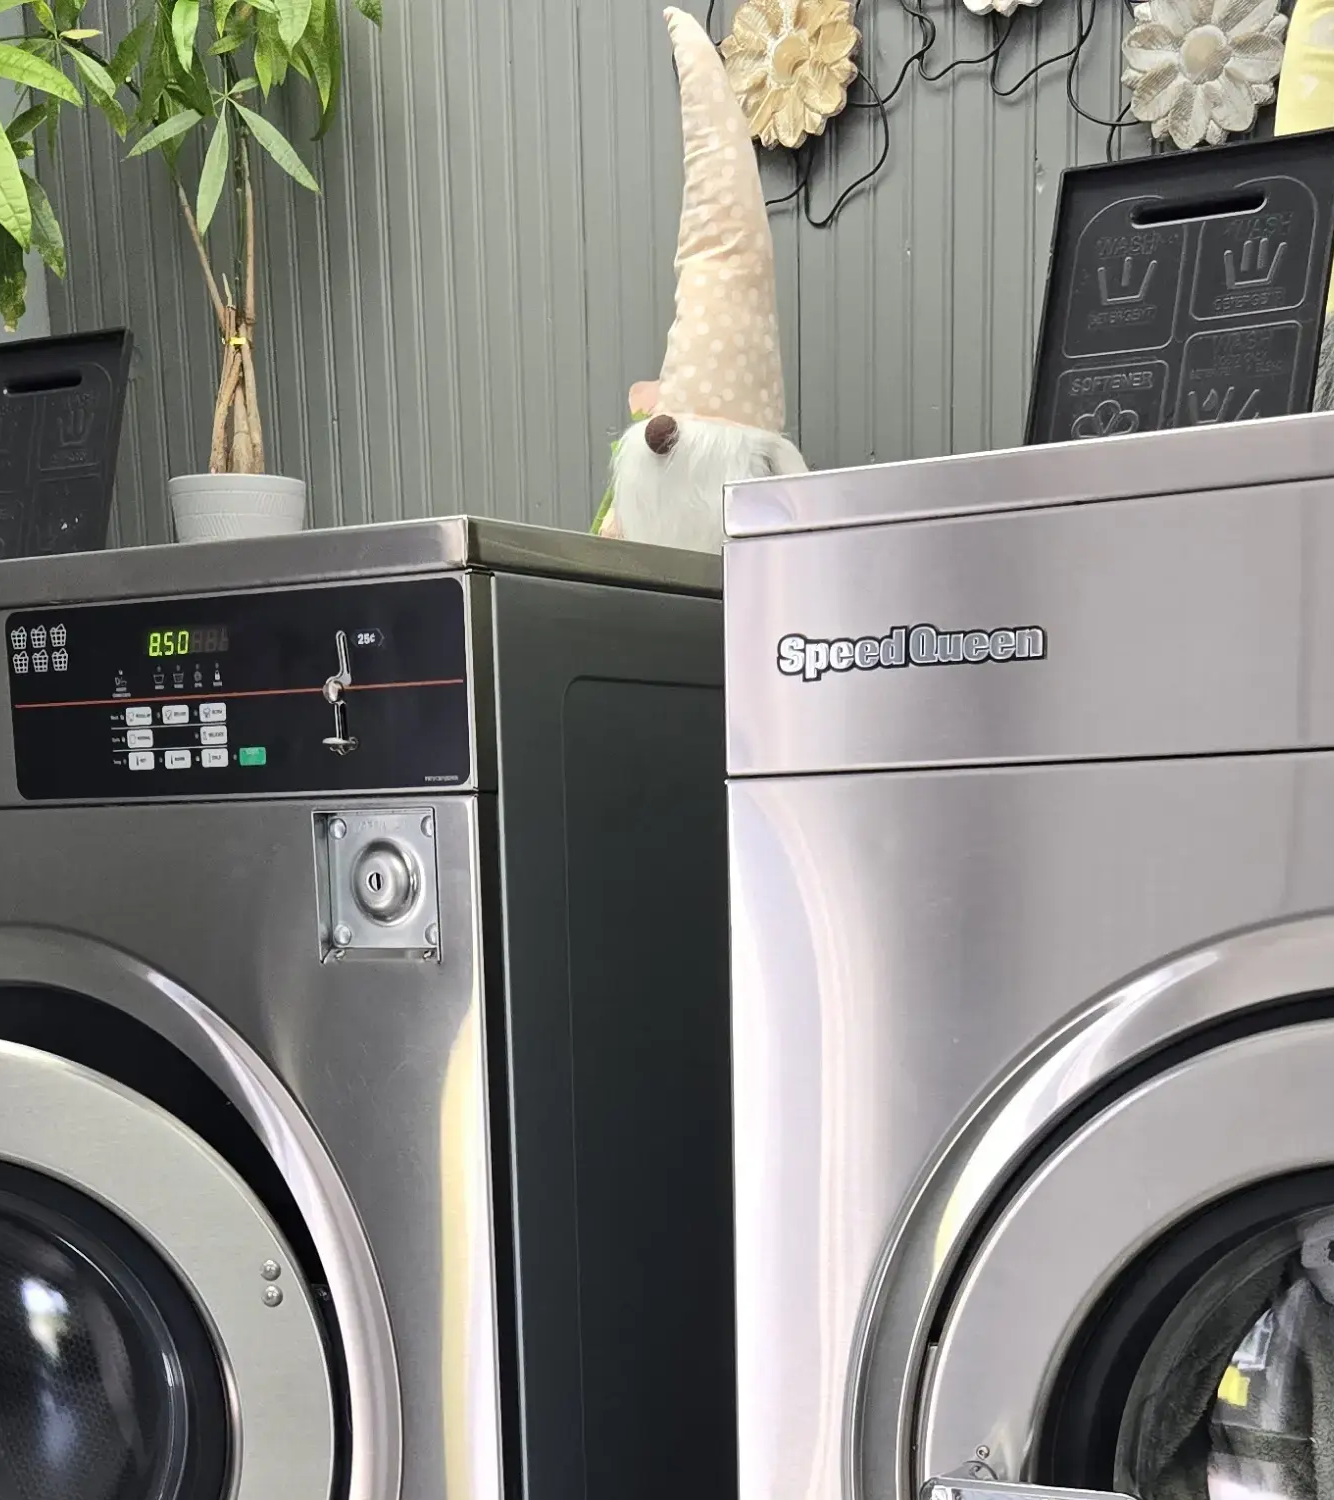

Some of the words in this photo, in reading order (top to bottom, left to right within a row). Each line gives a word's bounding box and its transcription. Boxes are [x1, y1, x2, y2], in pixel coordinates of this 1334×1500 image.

[1071, 371, 1153, 394] SOFTENER
[357, 632, 376, 645] 25¢
[777, 626, 909, 682] Speed
[908, 623, 1045, 666] Queen
